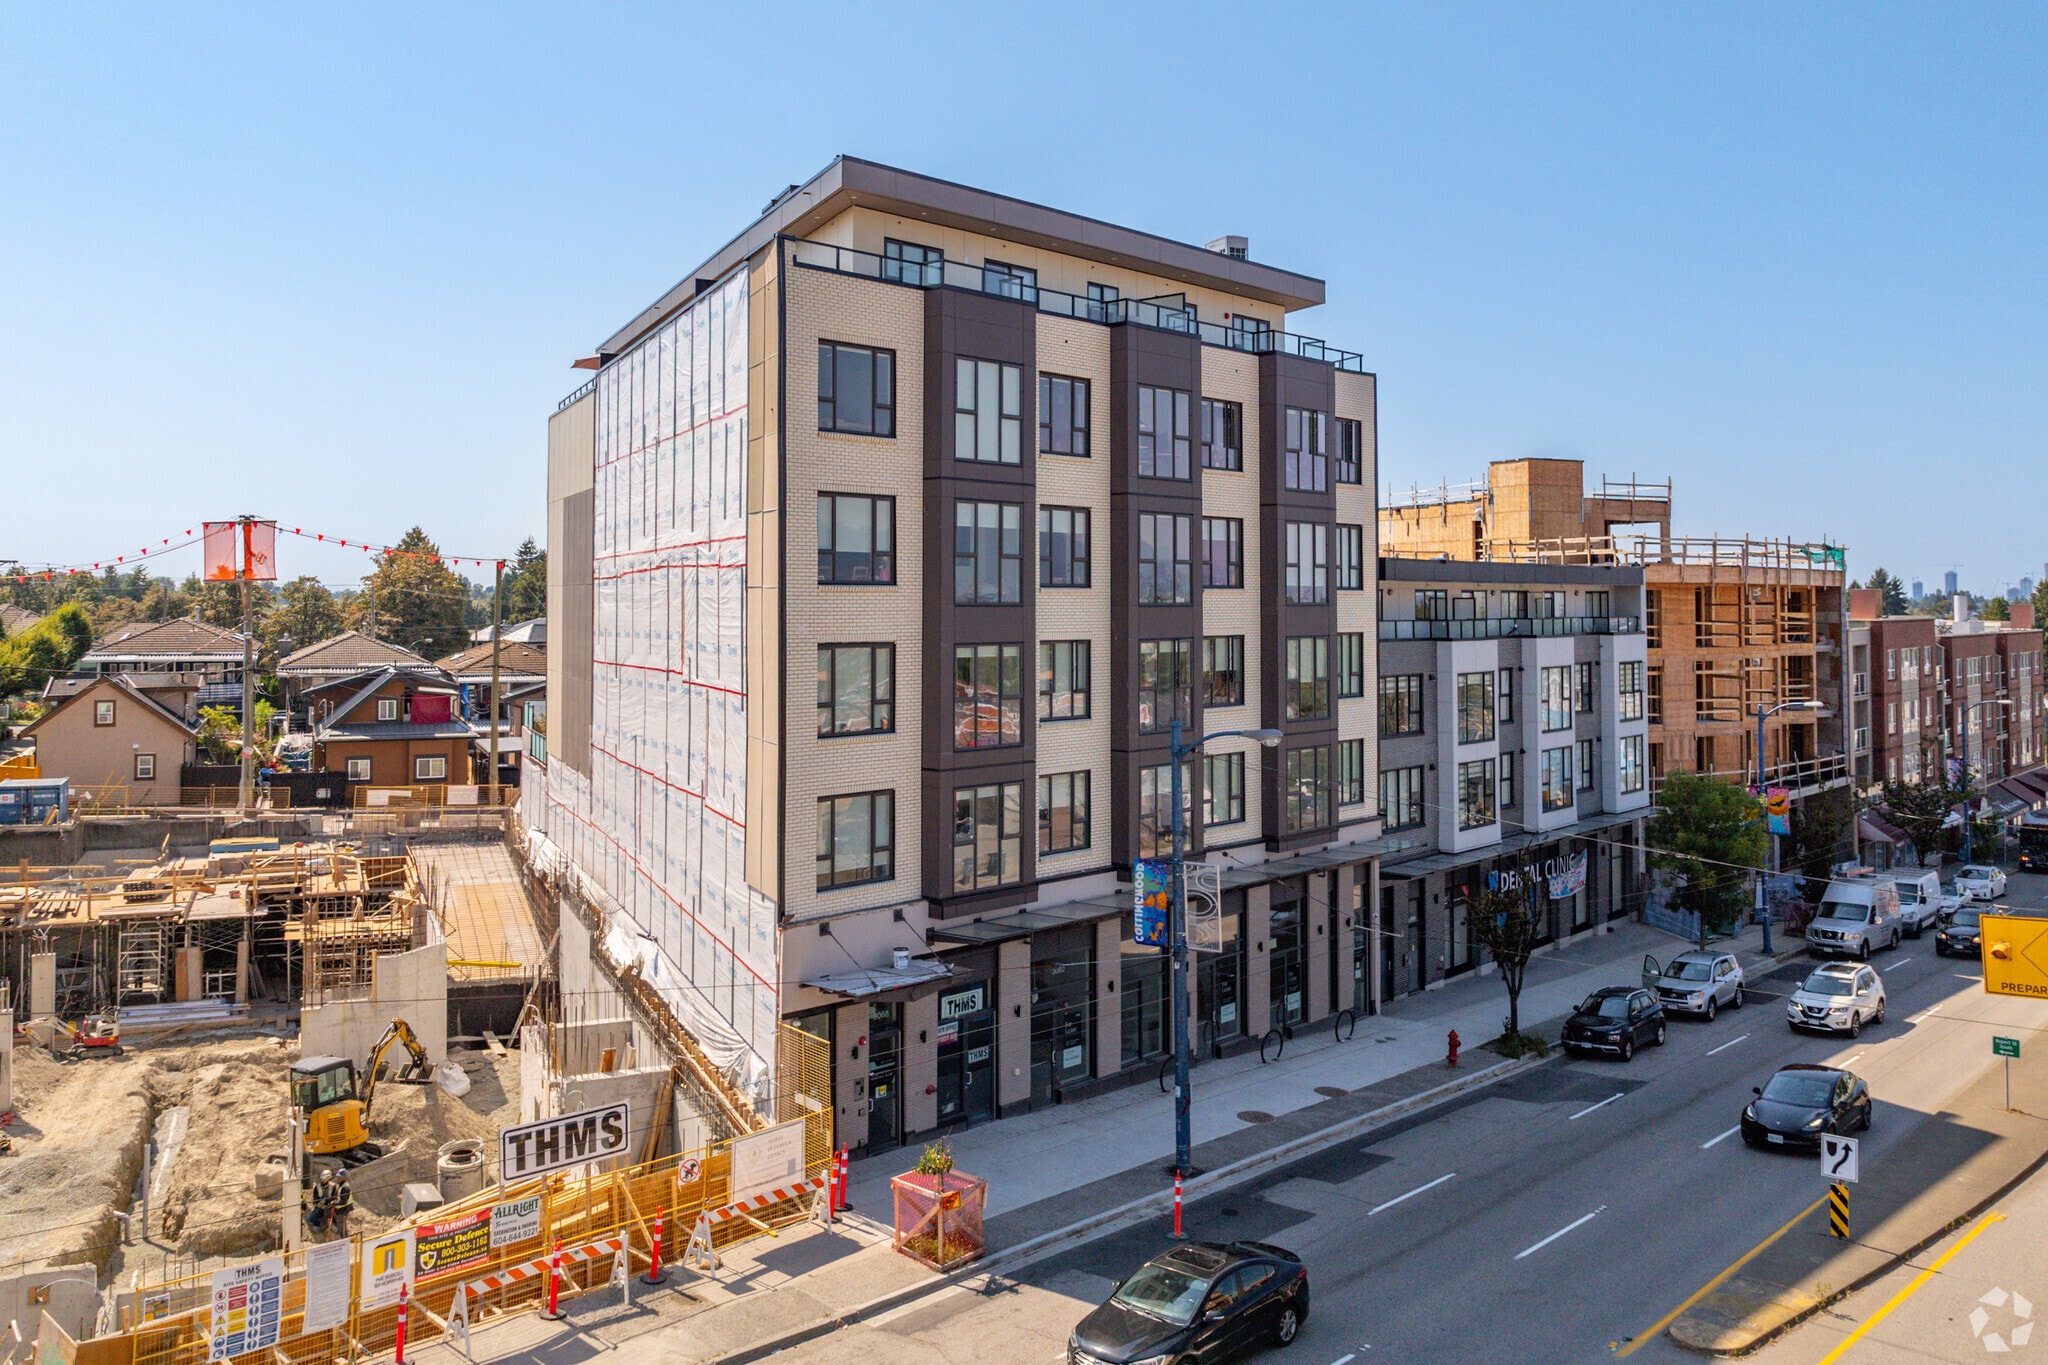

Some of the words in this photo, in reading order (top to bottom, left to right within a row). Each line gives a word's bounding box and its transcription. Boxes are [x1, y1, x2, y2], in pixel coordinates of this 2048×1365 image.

[1545, 853, 1575, 879] CLINIC
[1135, 863, 1145, 942] COLLINGWOOD
[947, 994, 977, 1015] THMS
[969, 1048, 988, 1060] THMS
[508, 1110, 623, 1172] THMS
[494, 1198, 539, 1219] ALLRIGHT
[434, 1215, 477, 1234] WARNING
[417, 1239, 452, 1252] Secure
[454, 1226, 489, 1244] Defence
[235, 1264, 261, 1279] THMS
